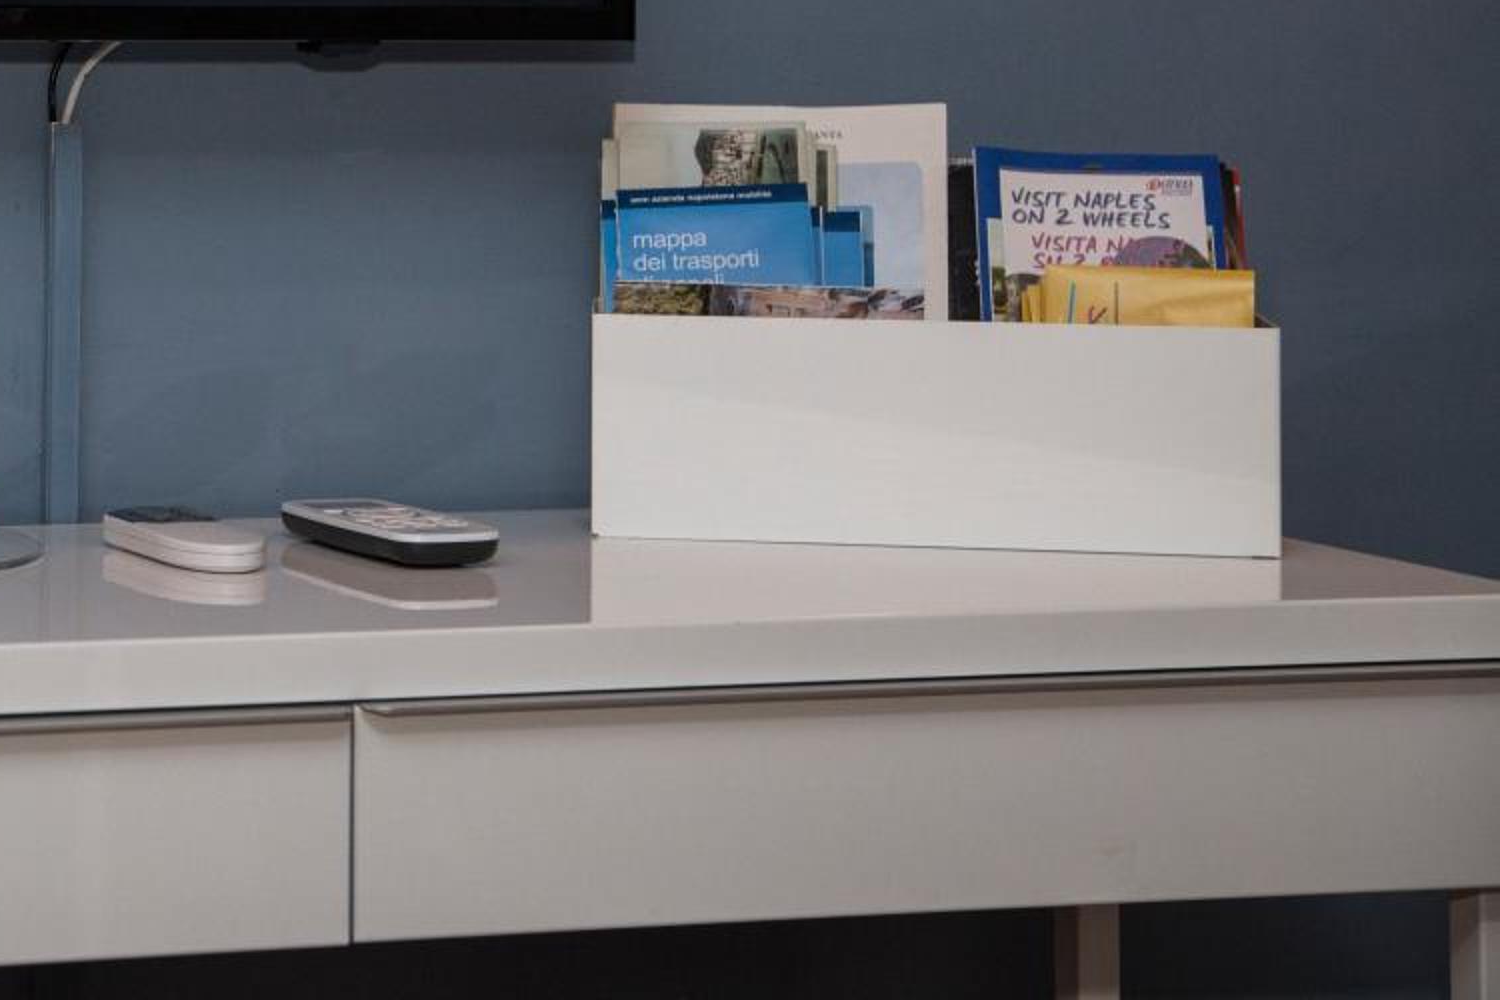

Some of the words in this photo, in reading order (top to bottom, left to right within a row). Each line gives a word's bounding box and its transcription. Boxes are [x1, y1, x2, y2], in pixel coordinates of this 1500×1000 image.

[1011, 186, 1068, 208] VISIT
[1073, 189, 1156, 211] NAPLES
[1011, 208, 1045, 225] ON
[1055, 209, 1075, 225] 2
[1082, 211, 1171, 229] WHEELS
[632, 231, 708, 251] mappa
[1031, 231, 1098, 252] VISITA
[632, 252, 666, 271] dei
[673, 247, 760, 272] trasporti
